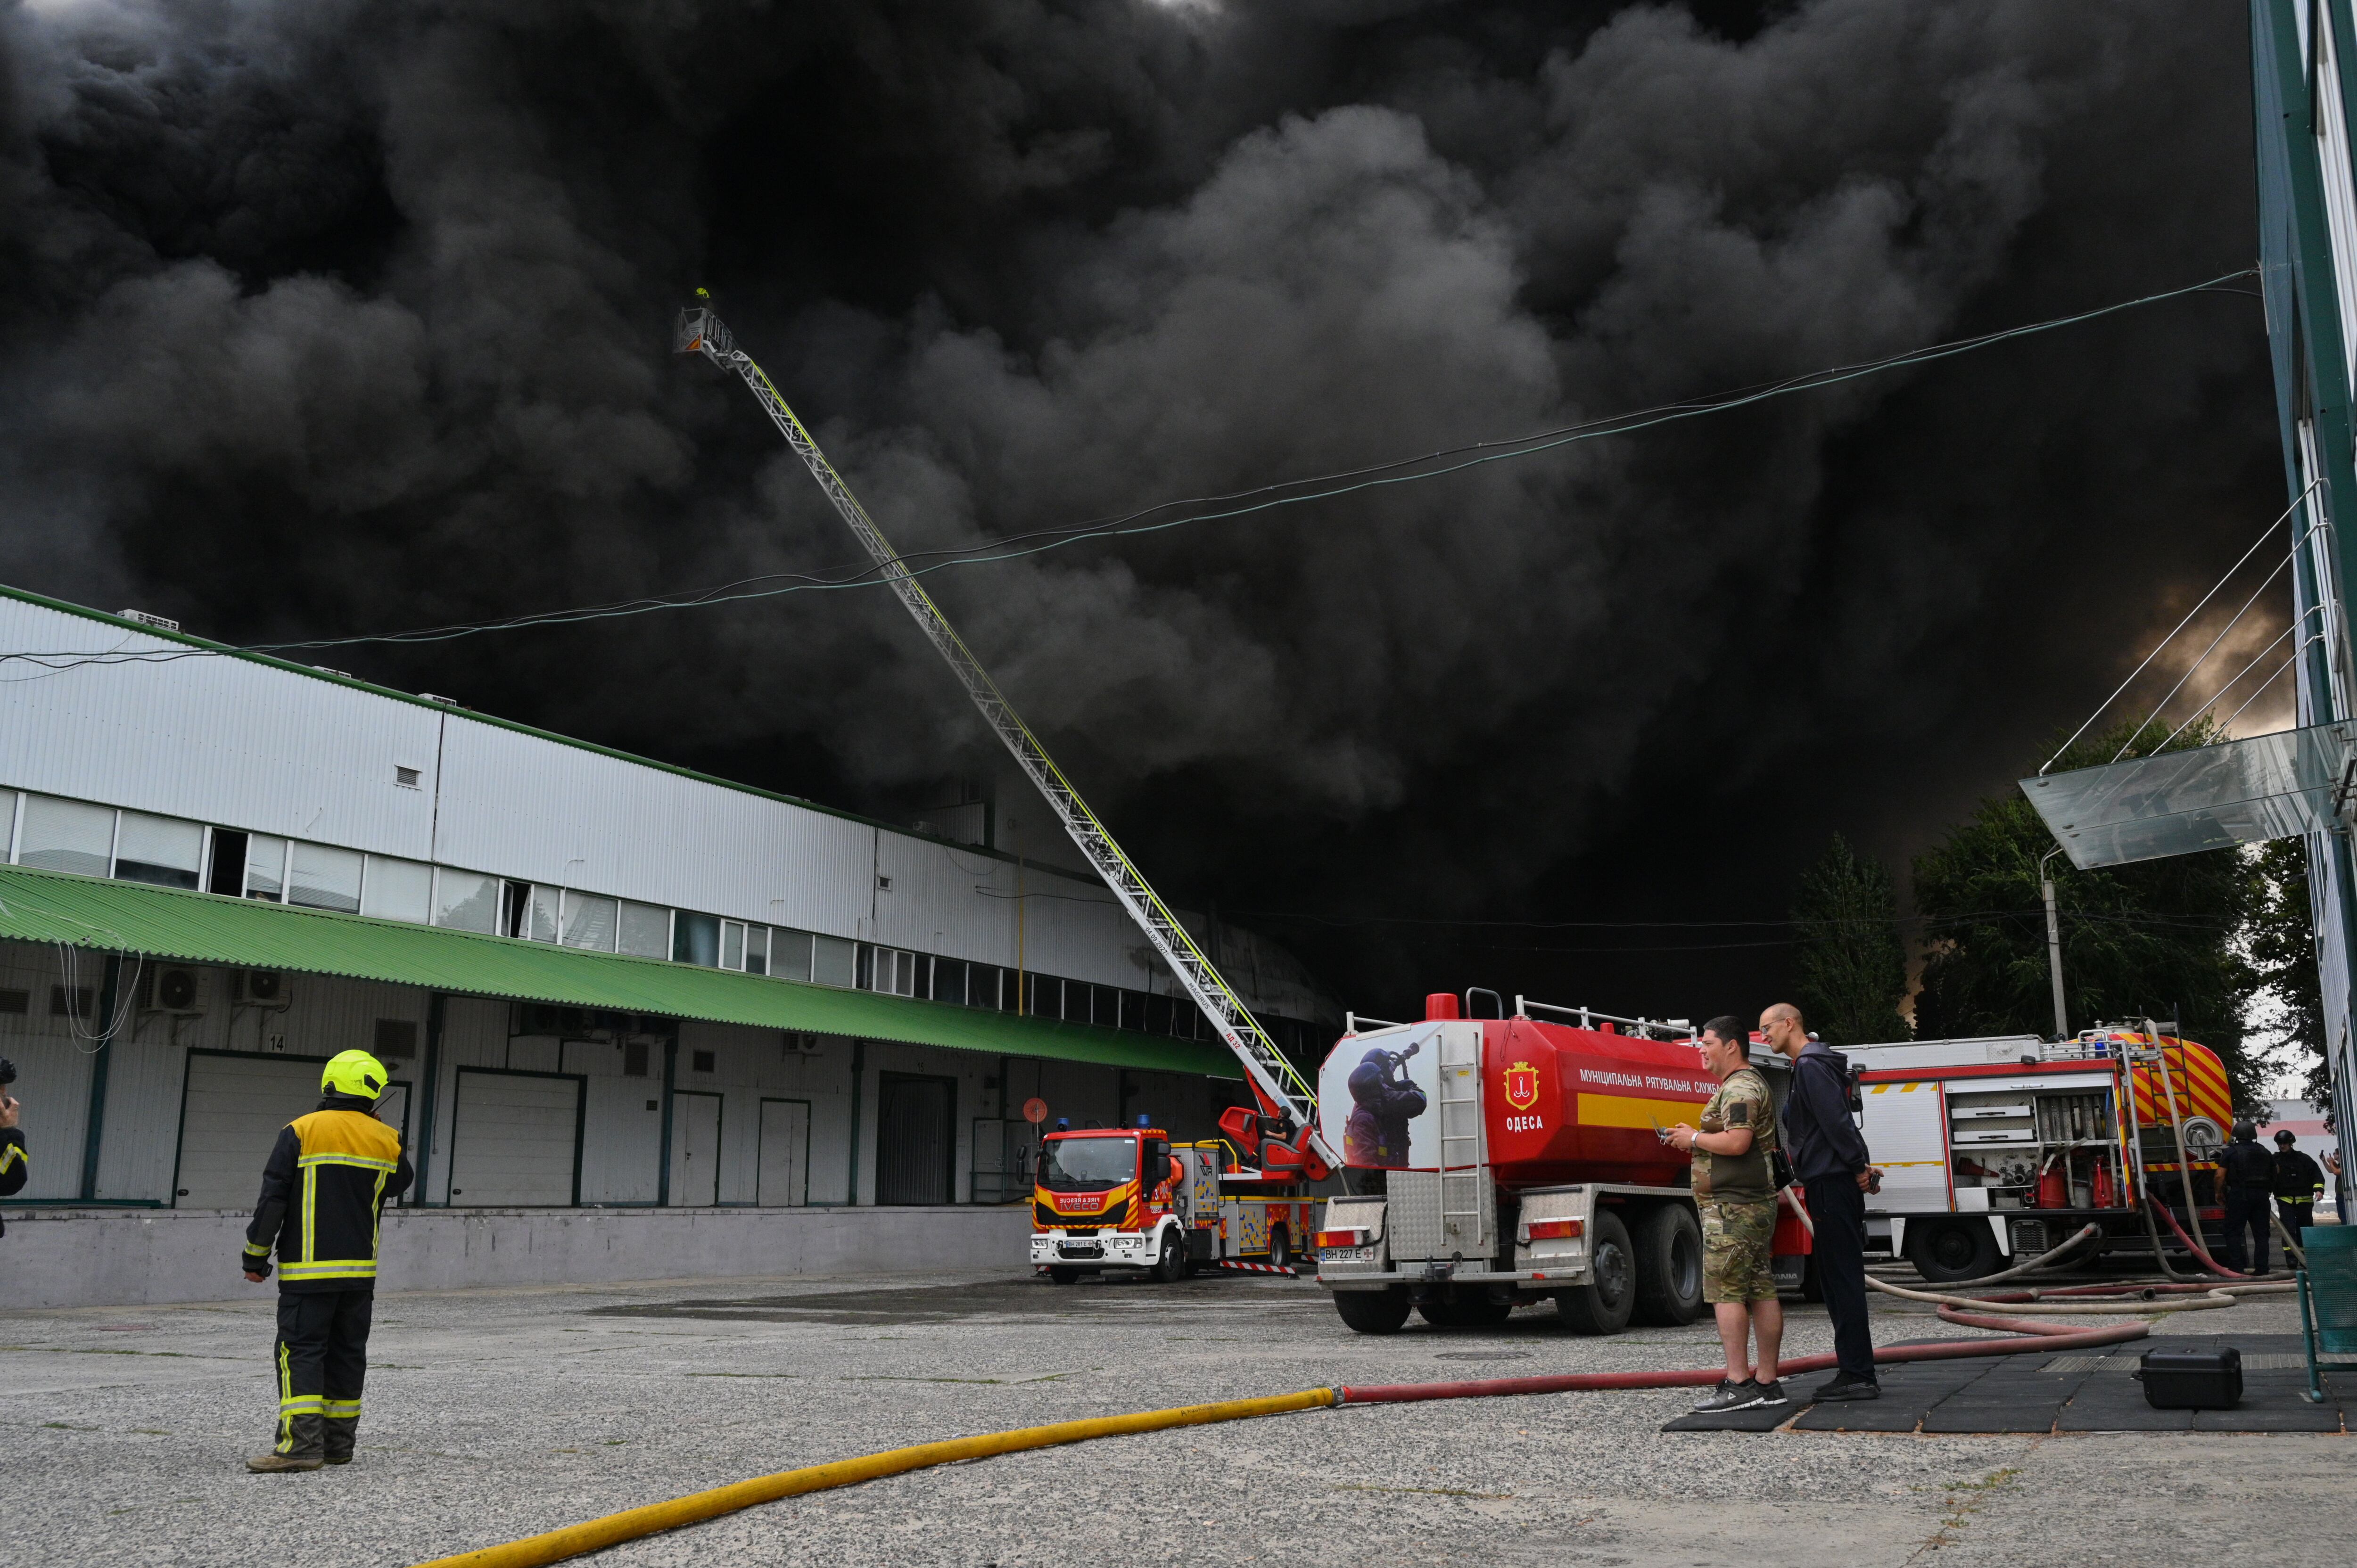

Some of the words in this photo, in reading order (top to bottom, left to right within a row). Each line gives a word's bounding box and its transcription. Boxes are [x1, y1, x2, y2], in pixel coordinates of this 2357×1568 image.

[1145, 927, 1168, 954] 04.09.2027
[1188, 983, 1210, 1010] MAGIRUS
[271, 1035, 283, 1051] 14
[1226, 1033, 1235, 1043] АД
[1233, 1041, 1240, 1049] 32
[918, 1062, 924, 1073] 15
[1580, 1069, 1643, 1087] МУНІЦИПАЛЬНА
[1645, 1076, 1692, 1092] РЯТУВАЛЬНА
[1507, 1116, 1543, 1133] ОДЕСА
[1154, 1188, 1158, 1201] 3
[1061, 1202, 1099, 1210] IVECO
[1326, 1250, 1337, 1259] BH
[1339, 1249, 1352, 1258] 227
[1356, 1249, 1361, 1258] E
